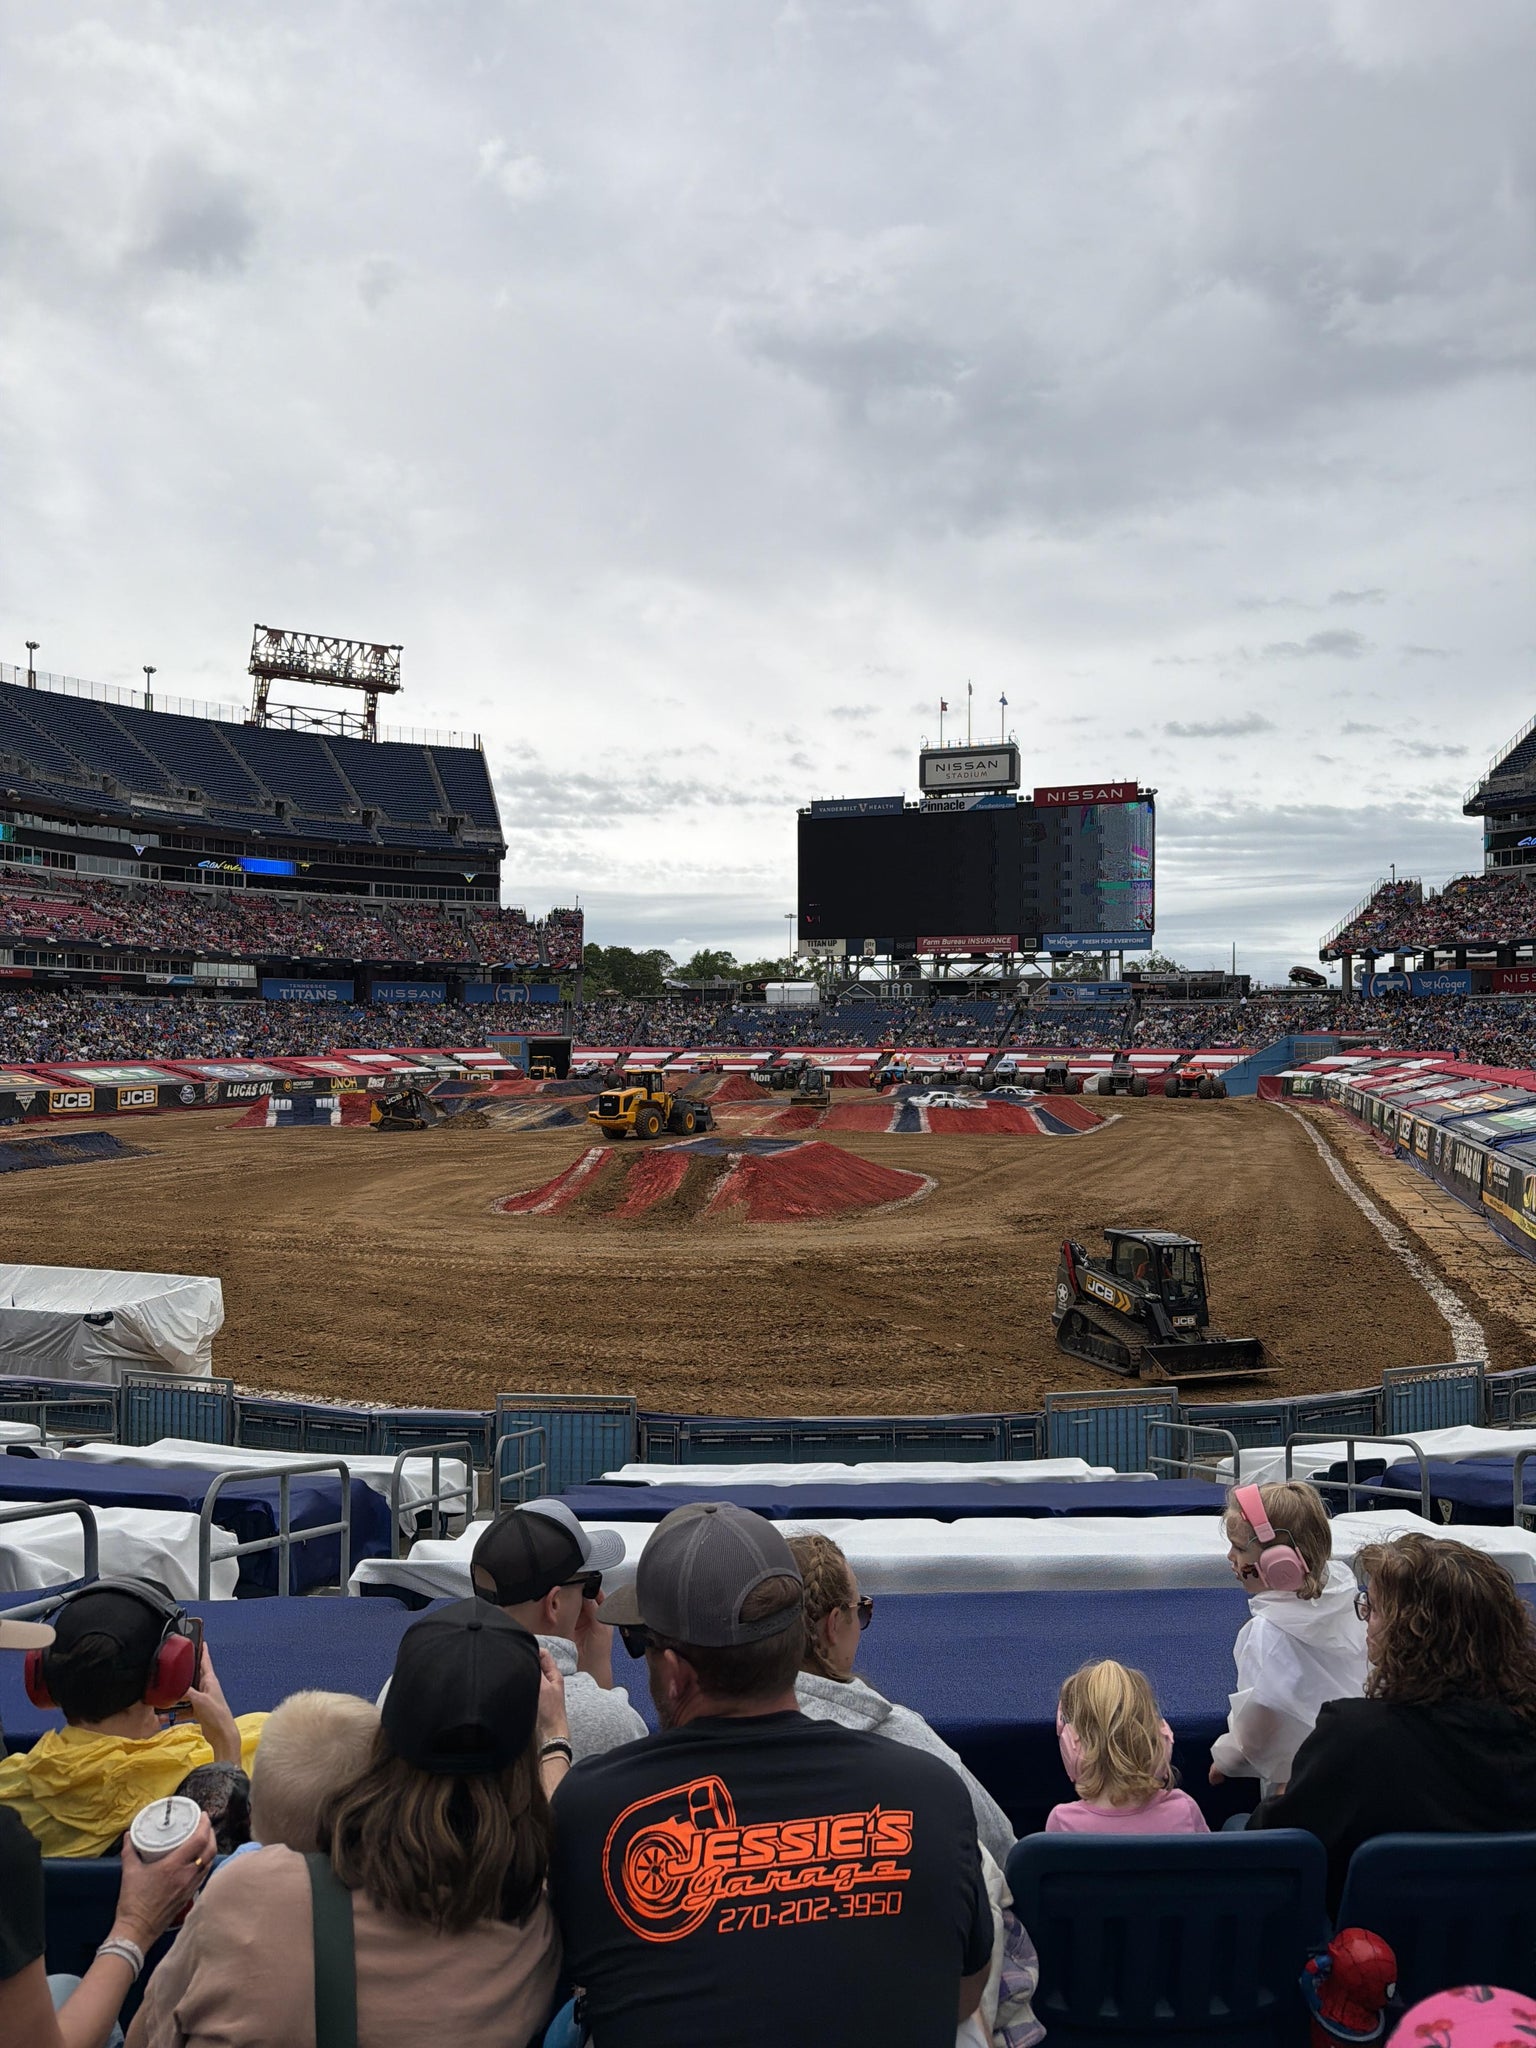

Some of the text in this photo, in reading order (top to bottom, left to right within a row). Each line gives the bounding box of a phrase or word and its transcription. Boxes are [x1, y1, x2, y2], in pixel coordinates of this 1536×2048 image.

[936, 760, 998, 772] NISSAN
[946, 771, 988, 779] STADIUM
[1047, 788, 1123, 802] NISSAN
[819, 805, 857, 813] VANDERBILT
[920, 800, 966, 812] Pinnacle
[1057, 936, 1079, 949] Kroger
[1434, 975, 1466, 993] Kroger
[279, 988, 338, 1000] TITANS
[378, 989, 442, 999] NISSAN
[227, 1082, 274, 1098] LUCAS OIL
[331, 1077, 357, 1089] UNOH
[53, 1093, 91, 1108] JCB
[121, 1089, 155, 1106] JCB
[1455, 1143, 1473, 1179] LUCAS
[1087, 1280, 1115, 1302] JCB
[1174, 1317, 1195, 1325] JCB
[665, 1803, 914, 1877] JESSIE'S
[681, 1861, 912, 1910] Garage
[717, 1891, 903, 1934] 270-202-3950
